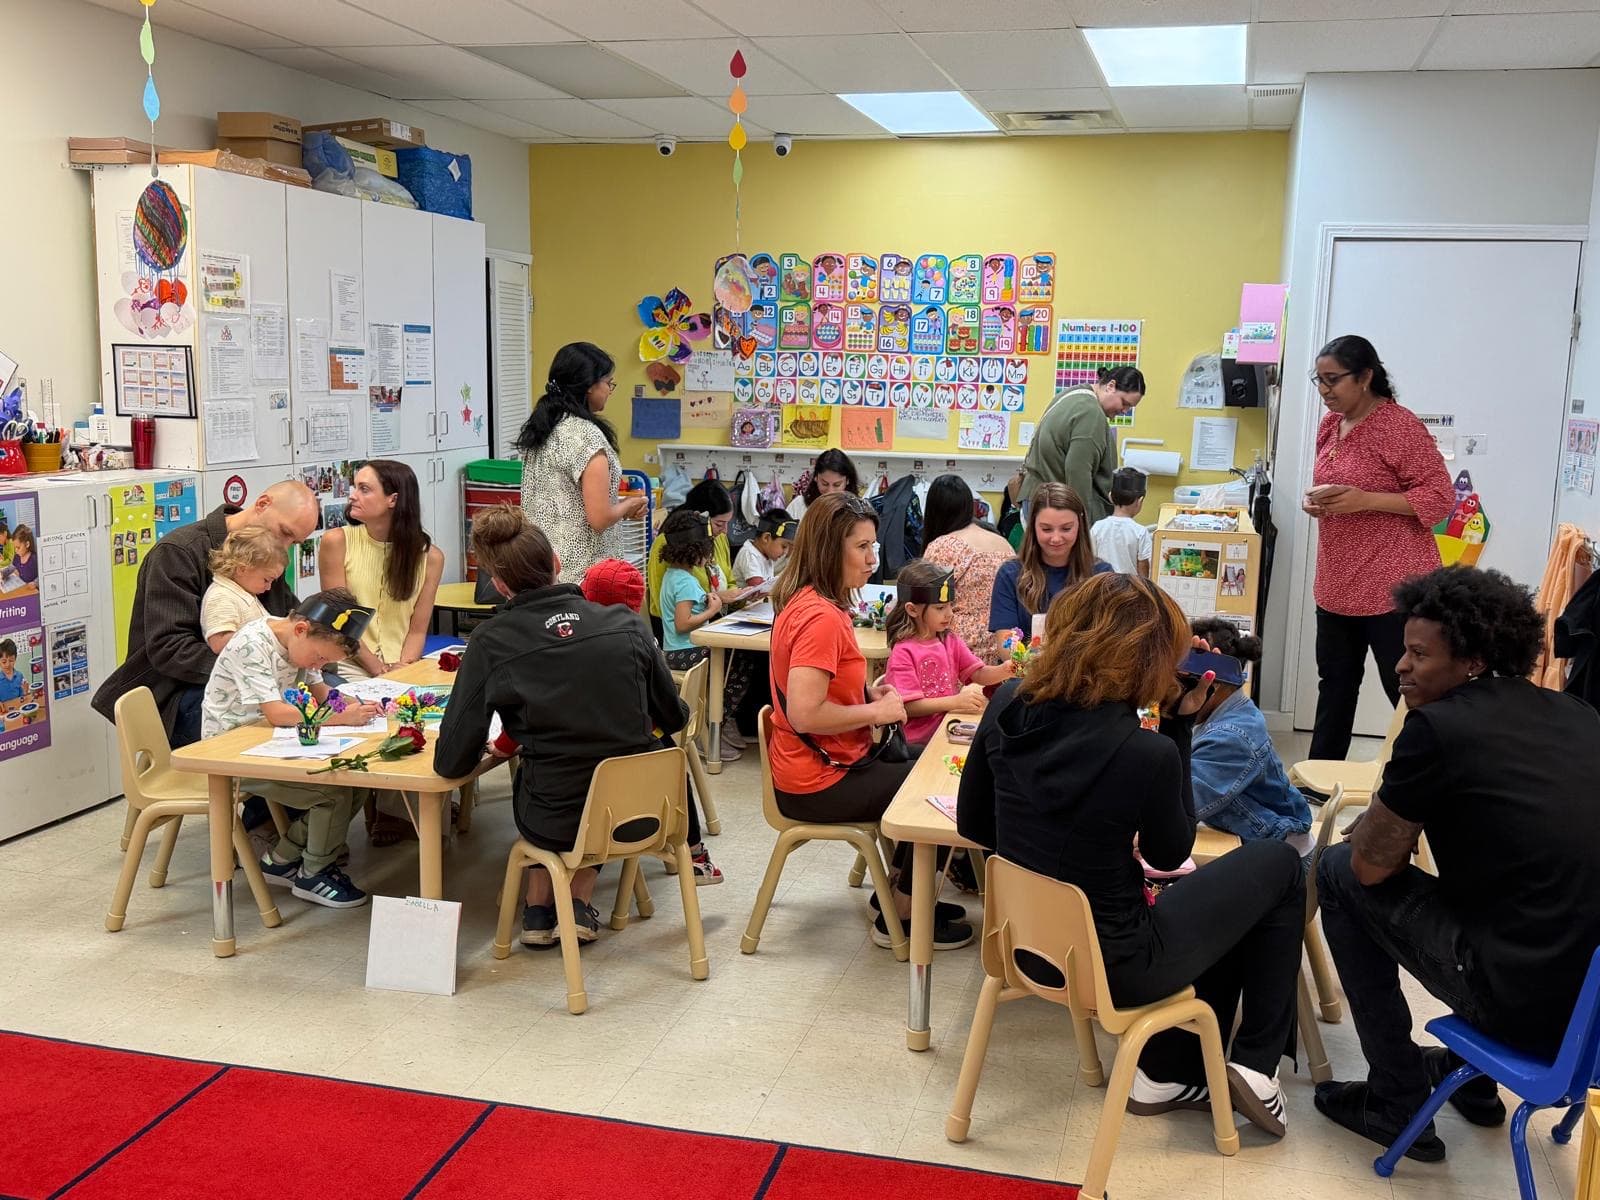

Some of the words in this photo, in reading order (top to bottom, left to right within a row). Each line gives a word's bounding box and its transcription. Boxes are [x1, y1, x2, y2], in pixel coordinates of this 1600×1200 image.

[786, 258, 793, 268] 3
[852, 260, 859, 268] 5
[886, 260, 893, 268] 6
[970, 260, 976, 268] 8
[1025, 268, 1035, 276] 10
[767, 288, 773, 296] 2
[819, 288, 825, 296] 4
[934, 290, 940, 298] 7
[989, 290, 995, 298] 9
[764, 307, 774, 316] 12
[784, 312, 794, 320] 13
[830, 312, 840, 320] 14
[850, 308, 859, 316] 15
[966, 310, 976, 319] 18
[1035, 310, 1048, 318] 20
[917, 322, 926, 330] 17
[1061, 322, 1107, 332] Numbers
[1110, 324, 1137, 332] 1-100
[882, 339, 892, 348] 16
[1000, 340, 1010, 348] 19
[737, 362, 750, 371] Aa
[759, 362, 772, 372] Bb
[781, 363, 793, 372] Cc
[802, 362, 815, 372] Dd
[826, 363, 837, 372] Ee
[849, 364, 860, 373] Ff
[870, 364, 883, 377] Gg
[893, 366, 906, 375] Hh
[940, 367, 950, 380] Jj
[962, 368, 974, 377] Kk
[1008, 370, 1024, 379] Mm
[737, 388, 750, 398] Nn
[757, 389, 770, 398] Oo
[780, 390, 792, 403] Pp
[801, 390, 816, 402] Qq
[825, 390, 835, 399] Rr
[847, 390, 857, 399] Ss
[893, 393, 906, 402] Uu
[916, 393, 927, 402] Vv
[937, 394, 952, 403] Ww
[961, 394, 972, 403] Xx
[984, 394, 995, 408] Yy
[1007, 396, 1018, 406] Zz
[0, 606, 26, 618] riting
[545, 612, 580, 629] CORTLAND
[0, 733, 39, 751] anguage
